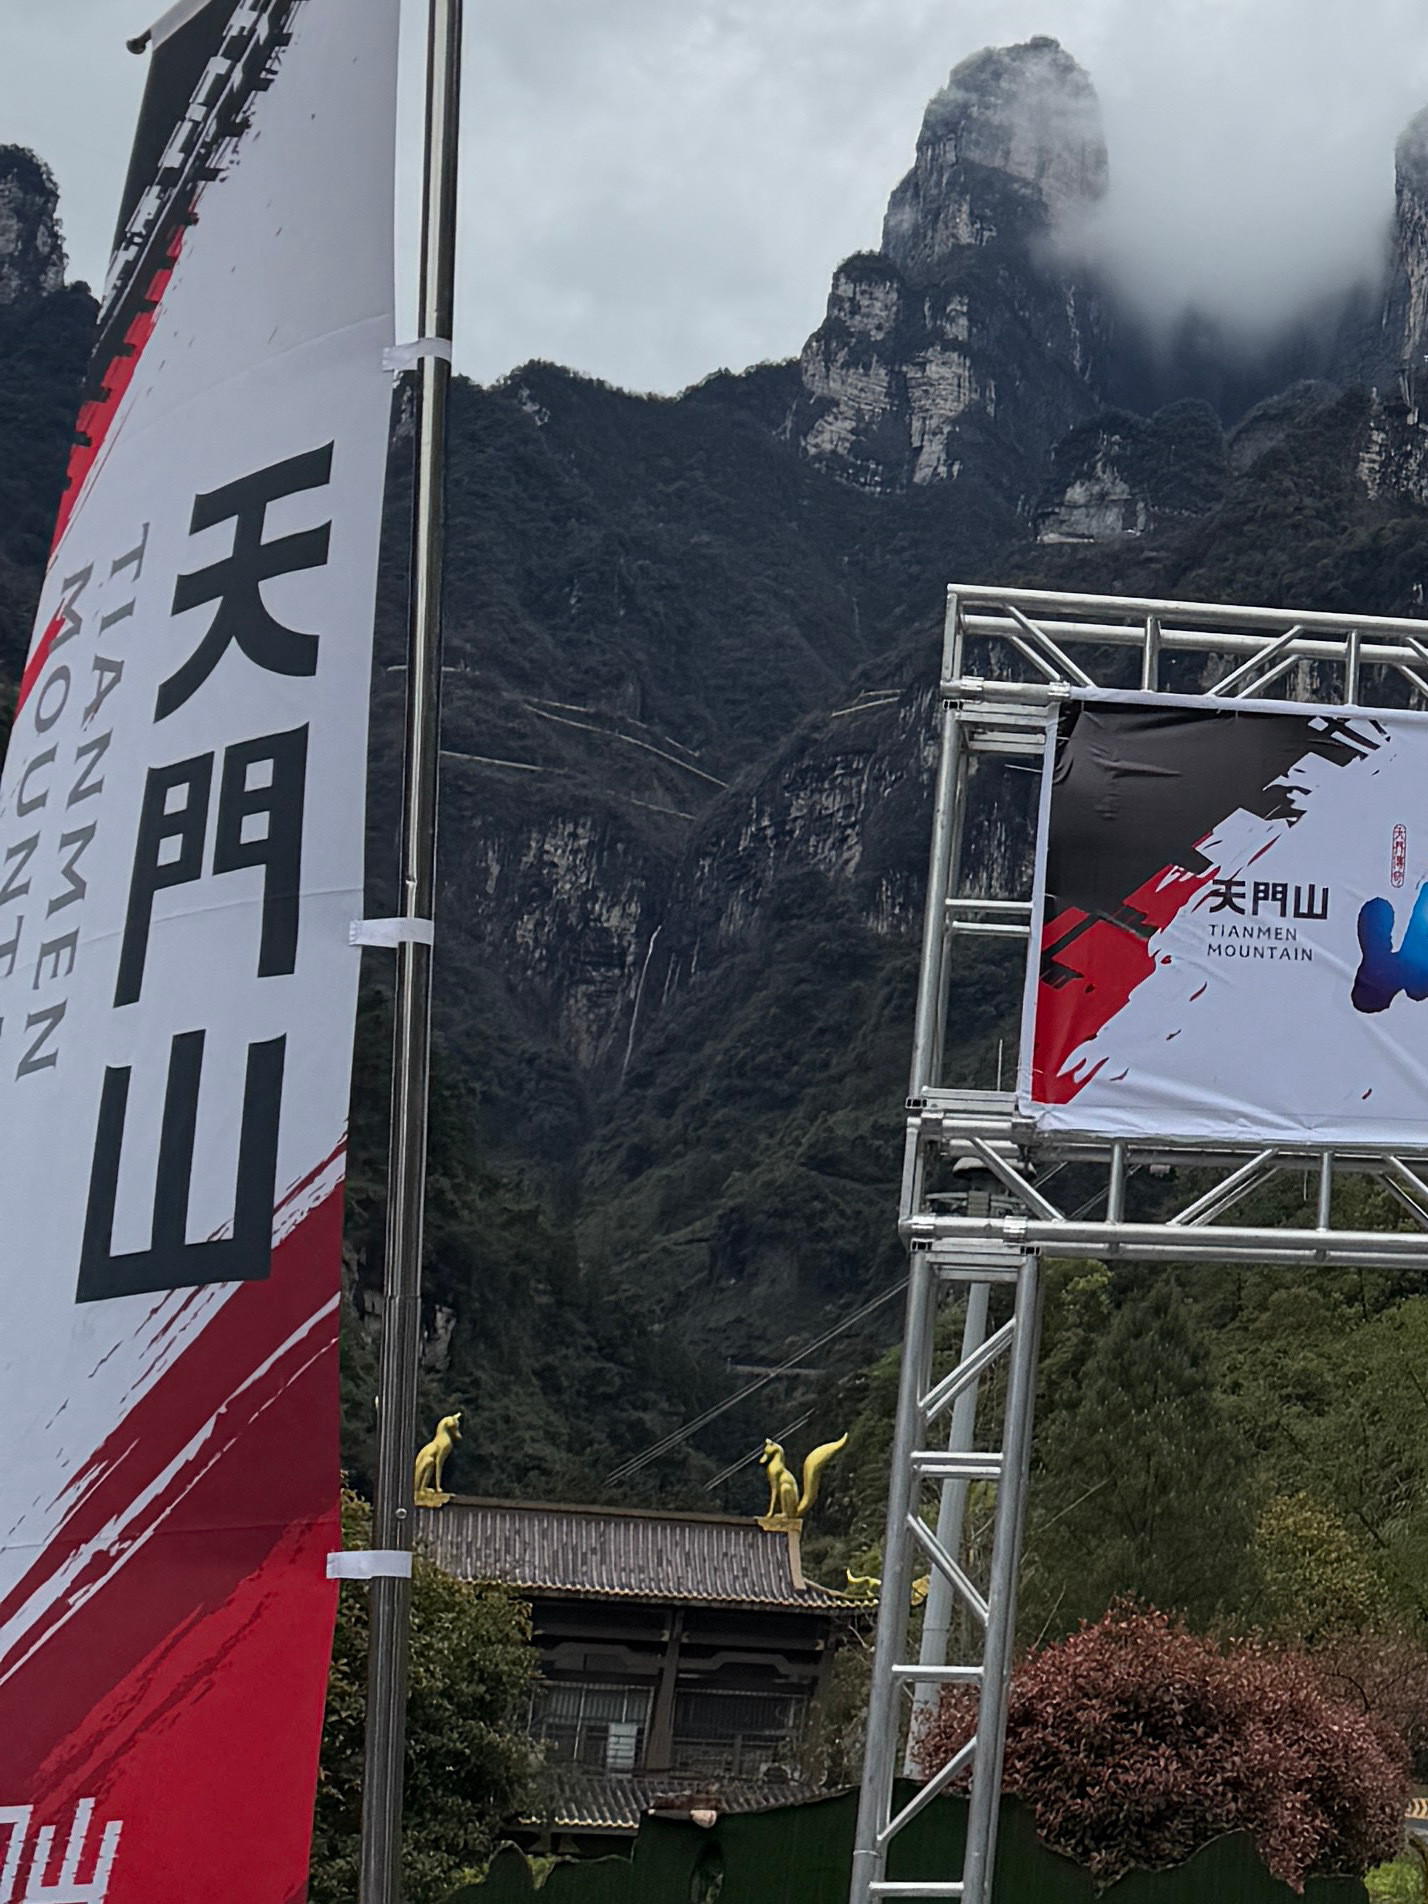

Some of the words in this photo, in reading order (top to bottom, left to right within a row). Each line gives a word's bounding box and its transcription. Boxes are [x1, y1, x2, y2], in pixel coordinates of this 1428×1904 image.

[0, 559, 94, 1041] MOUNT
[15, 522, 150, 1083] TIANMEN
[76, 439, 335, 1304] 天門山
[1208, 878, 1330, 921] 天門山
[1206, 943, 1314, 962] MOUNTAIN
[1208, 923, 1298, 942] TIANMEN
